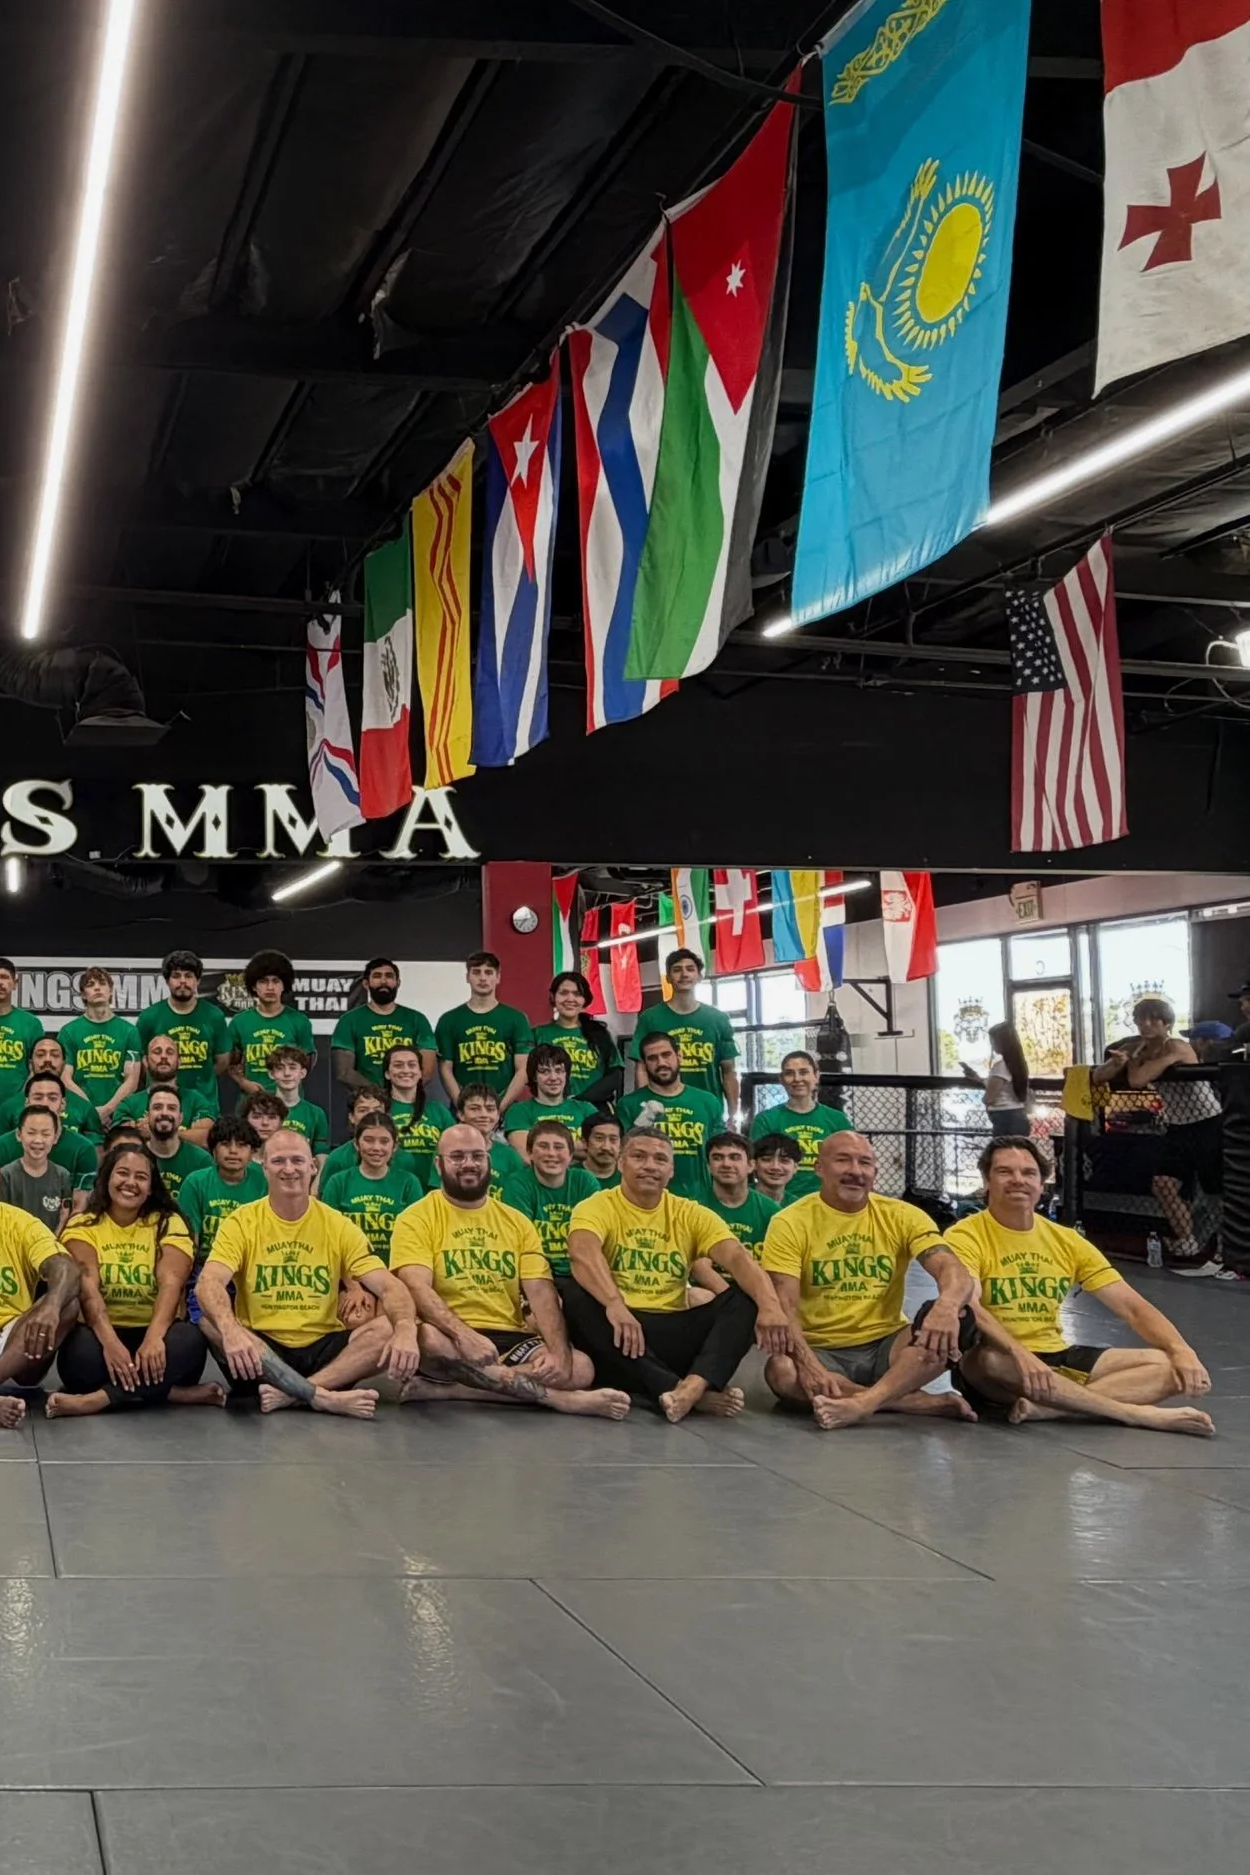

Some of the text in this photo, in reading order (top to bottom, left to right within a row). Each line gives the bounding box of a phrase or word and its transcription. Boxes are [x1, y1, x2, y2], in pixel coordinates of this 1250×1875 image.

[132, 783, 480, 859] MMA
[112, 973, 169, 1010] MM
[293, 978, 353, 992] MUAY
[295, 997, 348, 1011] THAI
[459, 1042, 506, 1062] KINGS
[77, 1049, 121, 1071] KINGS
[452, 1227, 473, 1239] MUAY
[651, 1229, 671, 1242] THAI
[267, 1241, 314, 1254] MUAY THAI
[827, 1234, 853, 1249] MUAY
[442, 1249, 516, 1279] KINGS
[612, 1244, 686, 1279] KINGS
[1000, 1252, 1029, 1267] MUAY
[811, 1255, 894, 1286] KINGS
[252, 1264, 331, 1295] KINGS
[634, 1275, 660, 1286] MMA
[112, 1288, 143, 1298] MMA
[276, 1291, 304, 1302] MMA
[986, 1276, 1072, 1306] KINGS
